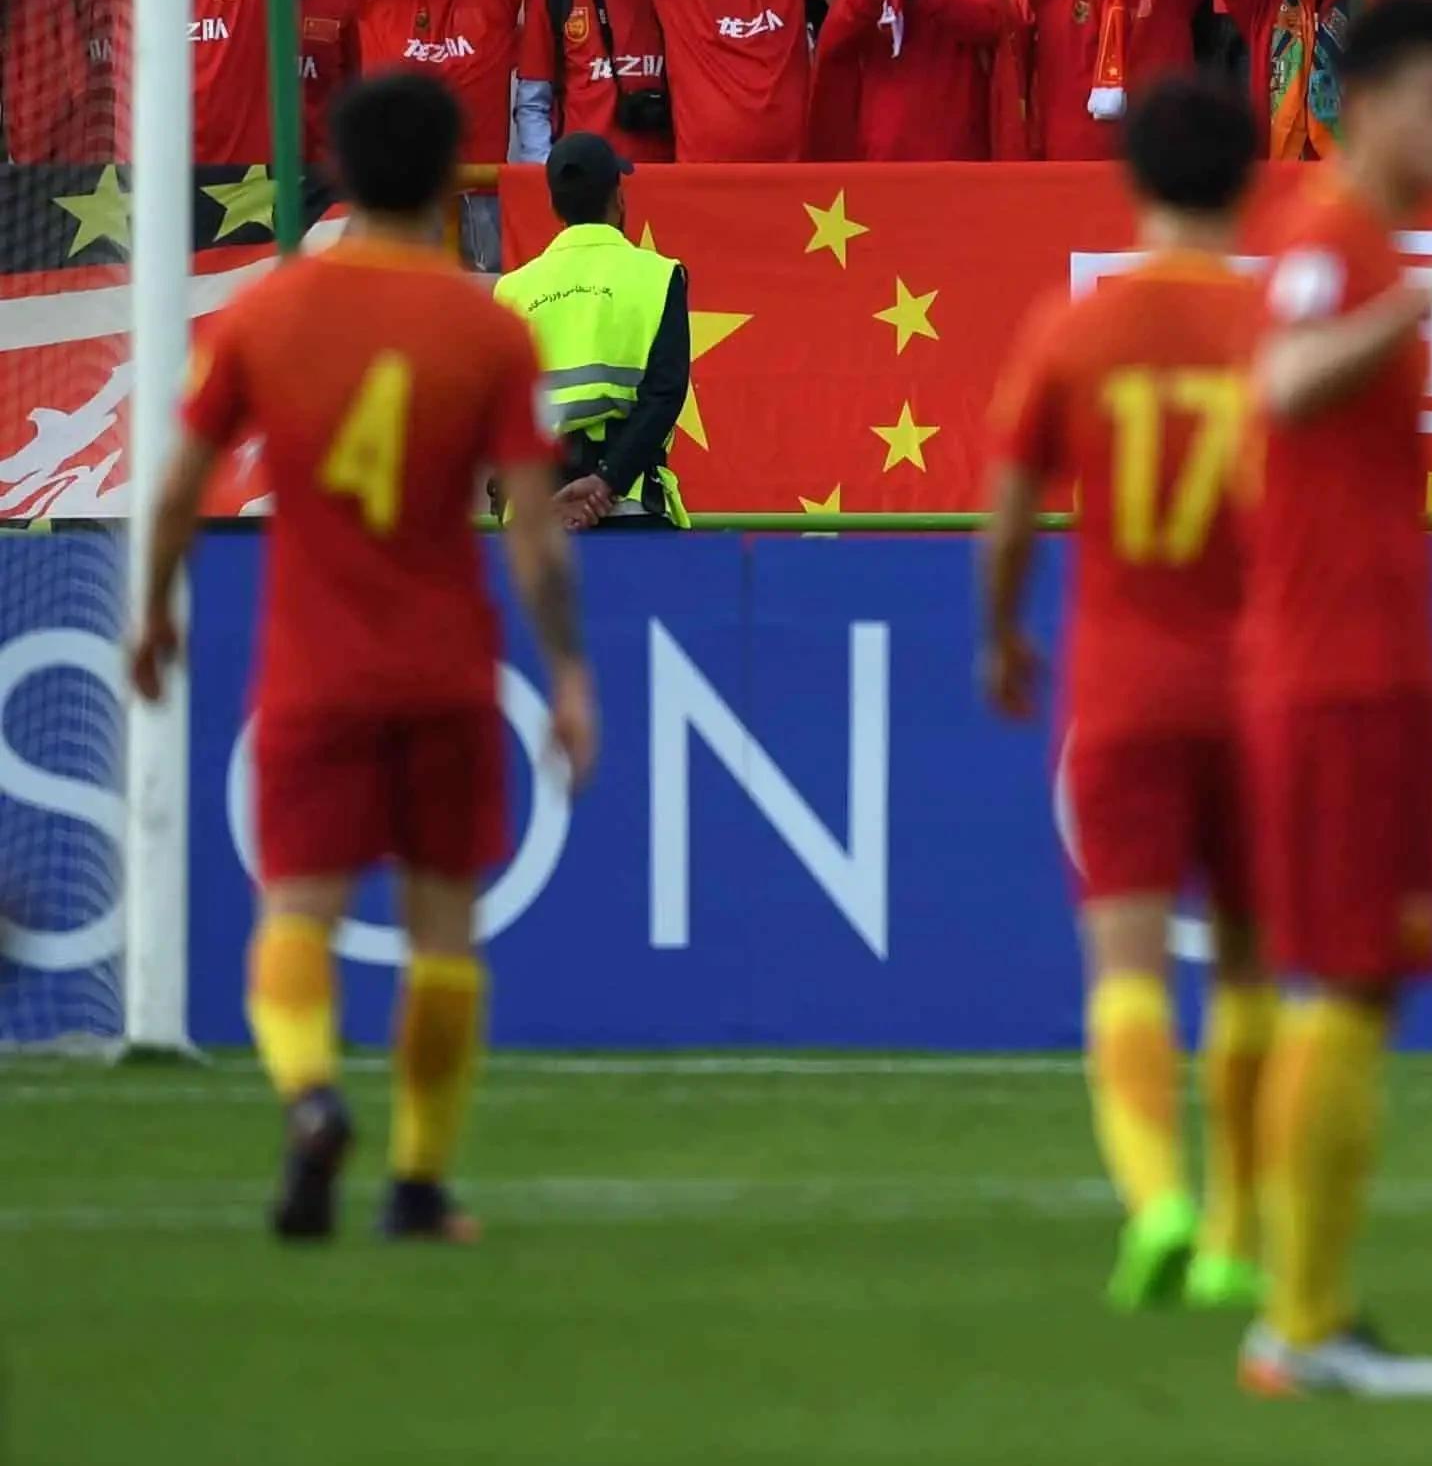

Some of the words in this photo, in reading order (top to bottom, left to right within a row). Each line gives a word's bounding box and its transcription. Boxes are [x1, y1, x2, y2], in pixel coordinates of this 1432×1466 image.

[185, 18, 229, 43] 之队
[403, 35, 476, 63] 龙之队
[319, 349, 412, 536] 4
[1100, 364, 1246, 564] 17
